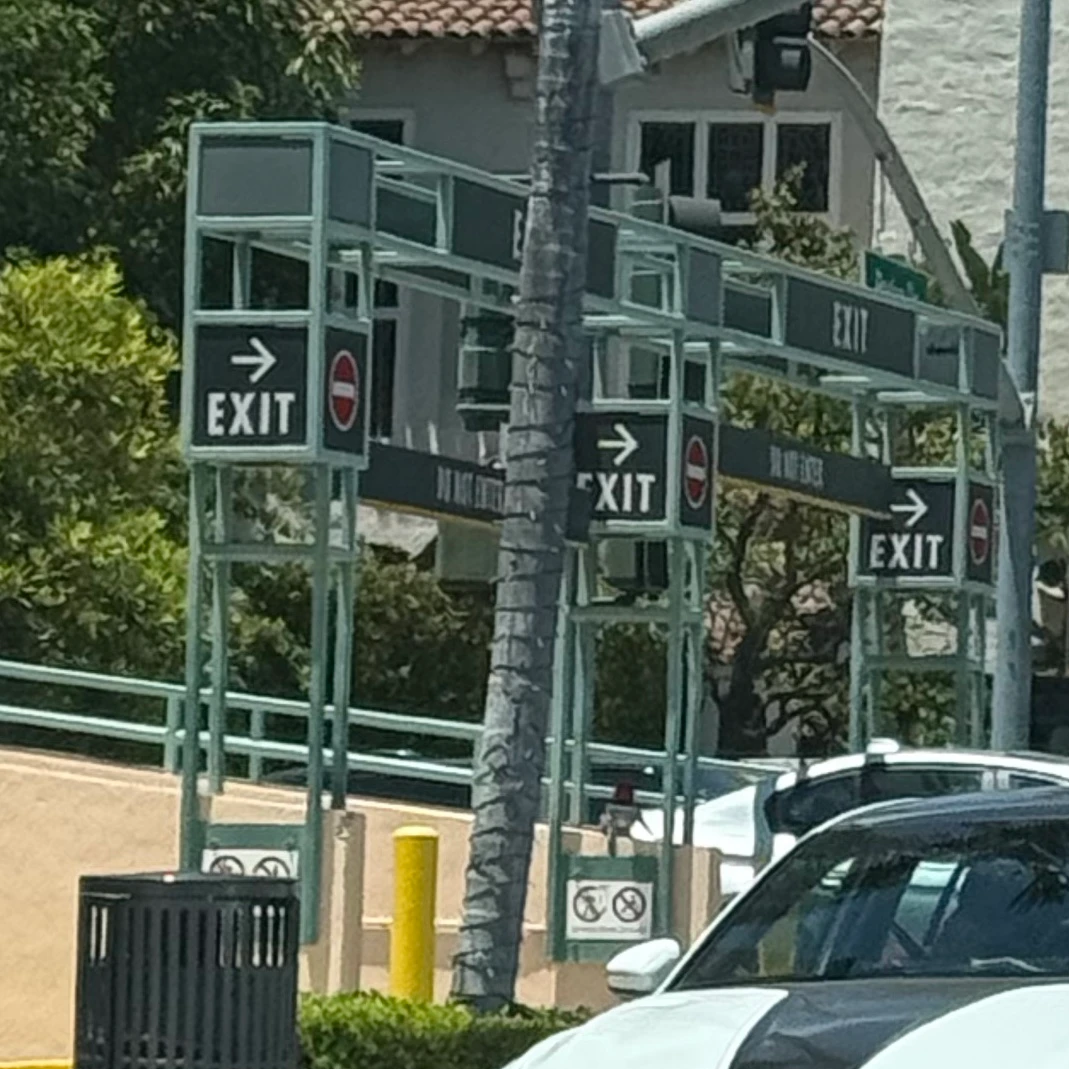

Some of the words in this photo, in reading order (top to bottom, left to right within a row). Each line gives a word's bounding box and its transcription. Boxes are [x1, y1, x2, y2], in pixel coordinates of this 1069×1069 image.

[832, 301, 869, 355] EXIT
[207, 391, 296, 436] EXIT
[868, 533, 945, 570] EXIT
